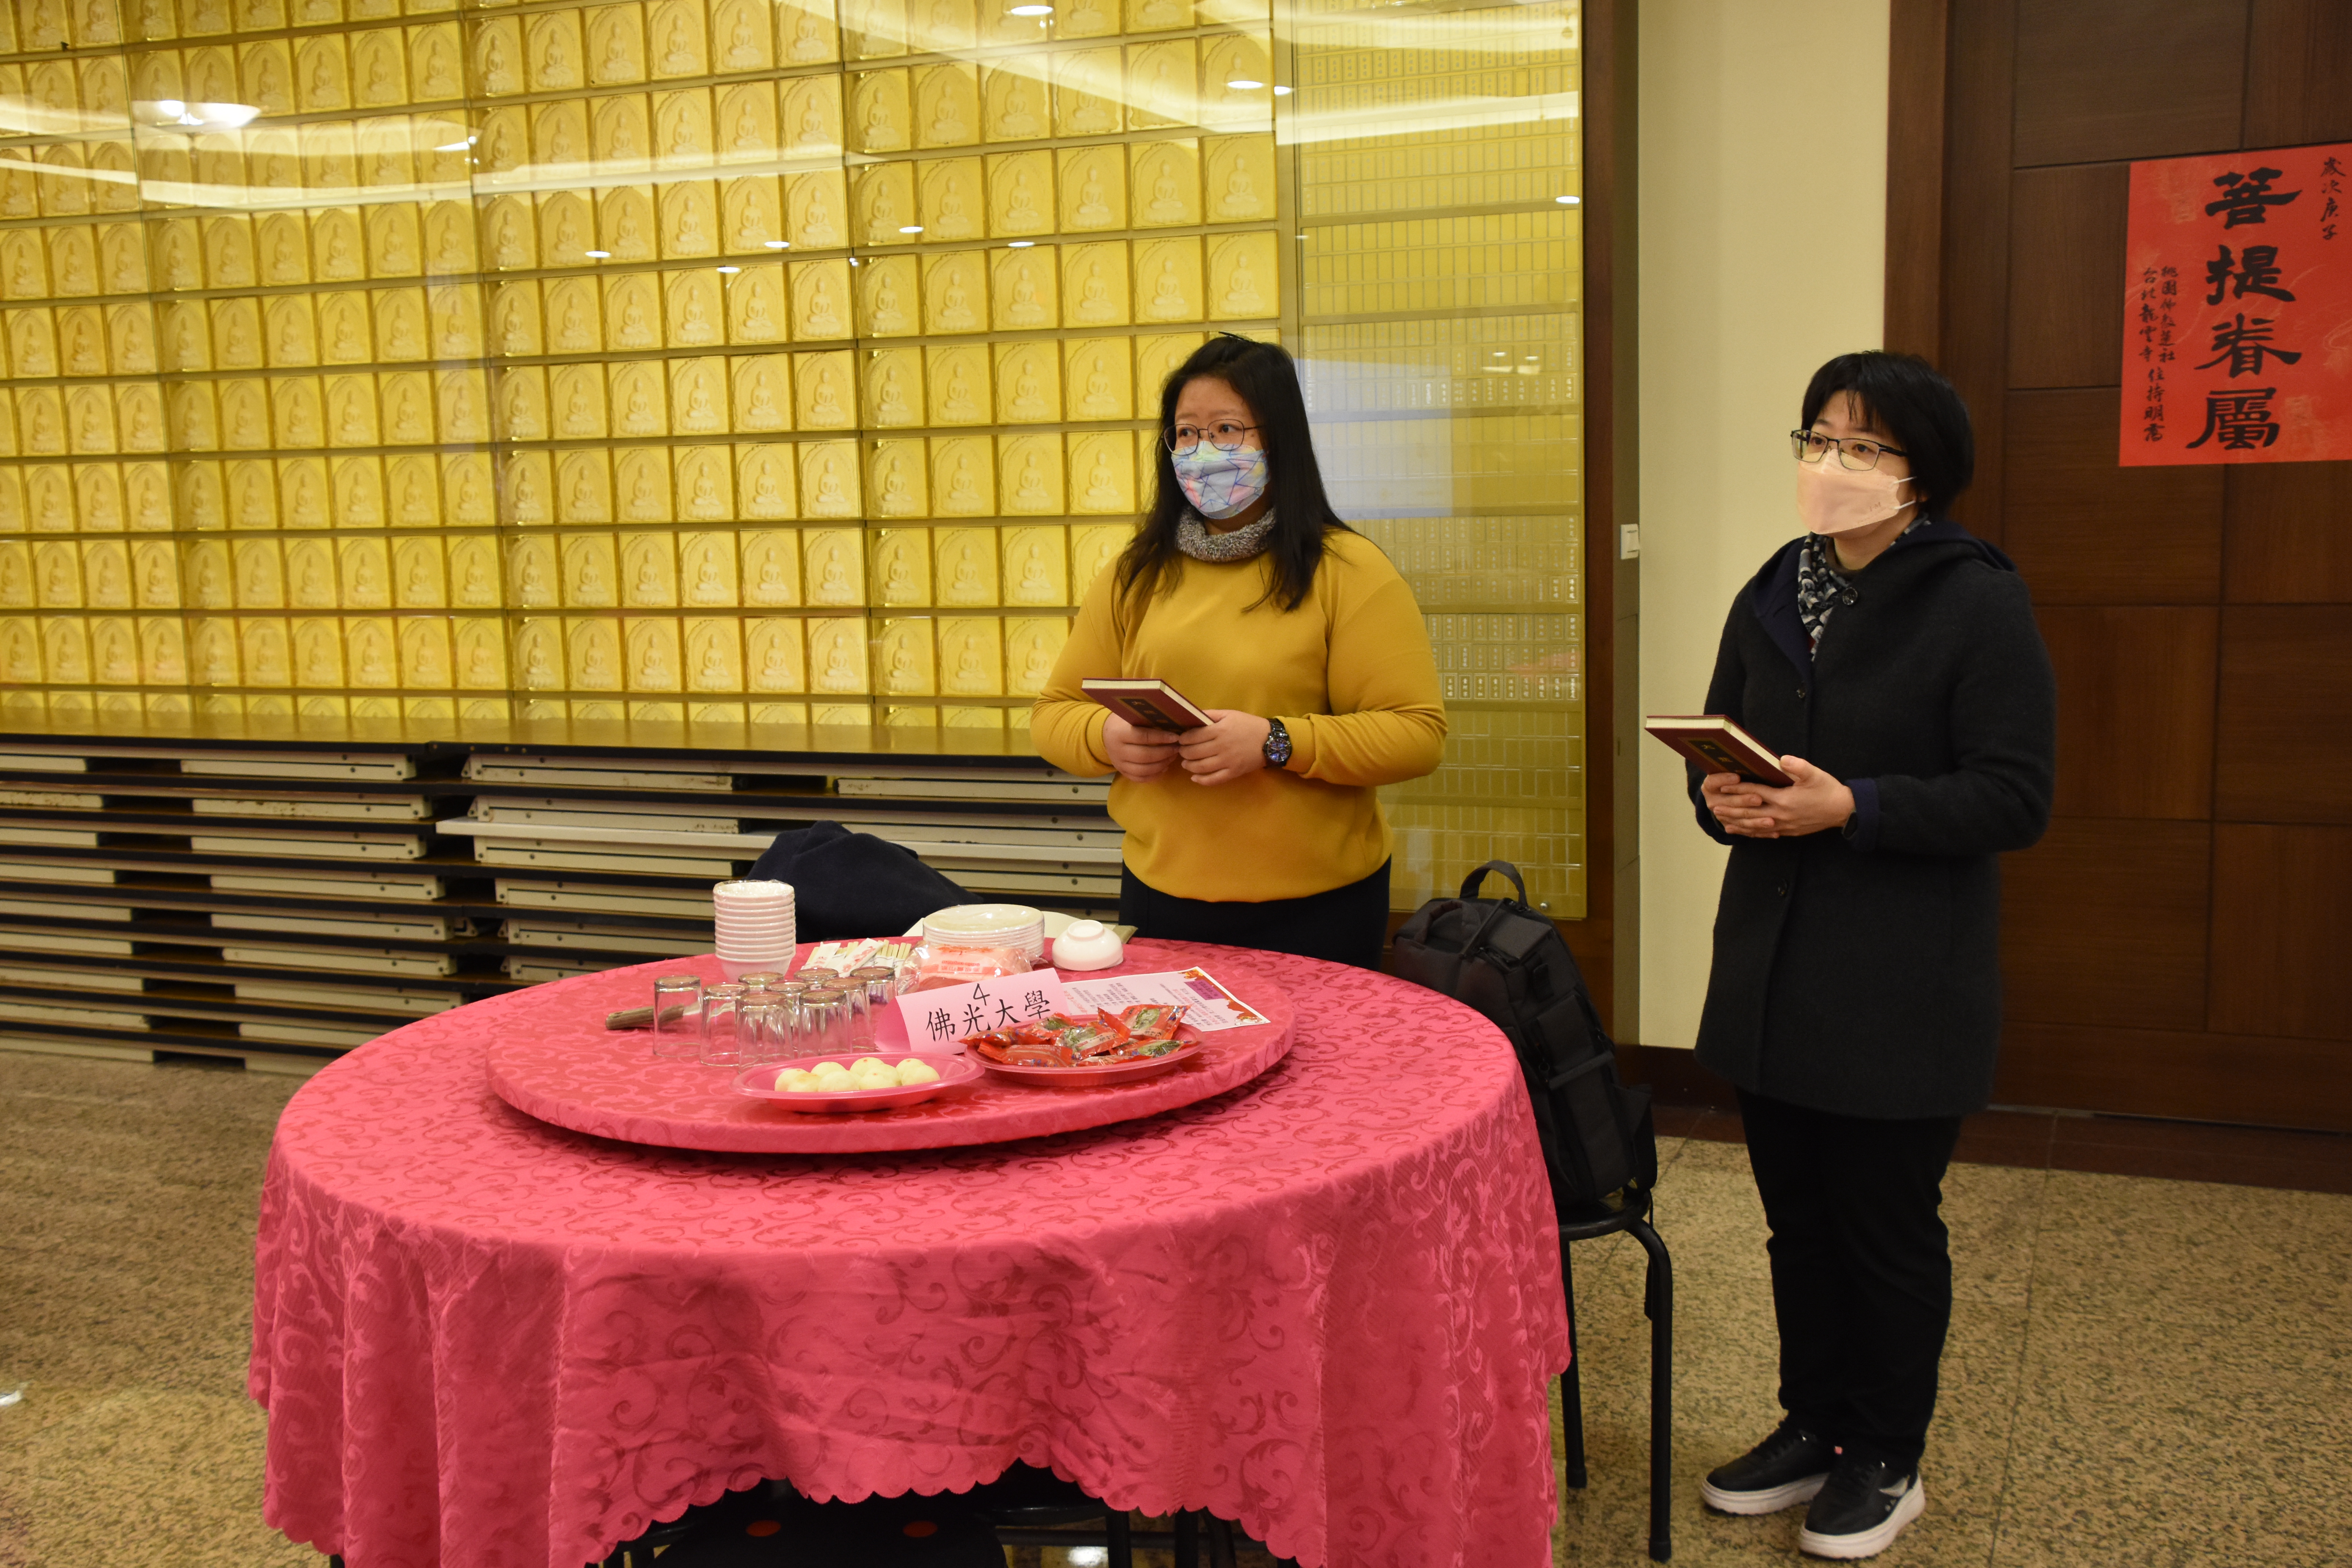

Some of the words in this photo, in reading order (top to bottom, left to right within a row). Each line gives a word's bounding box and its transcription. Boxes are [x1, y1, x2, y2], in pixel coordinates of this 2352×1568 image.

[2186, 167, 2302, 450] 菩提眷屬
[926, 990, 1050, 1042] 佛光大學
[973, 983, 991, 1006] 4
